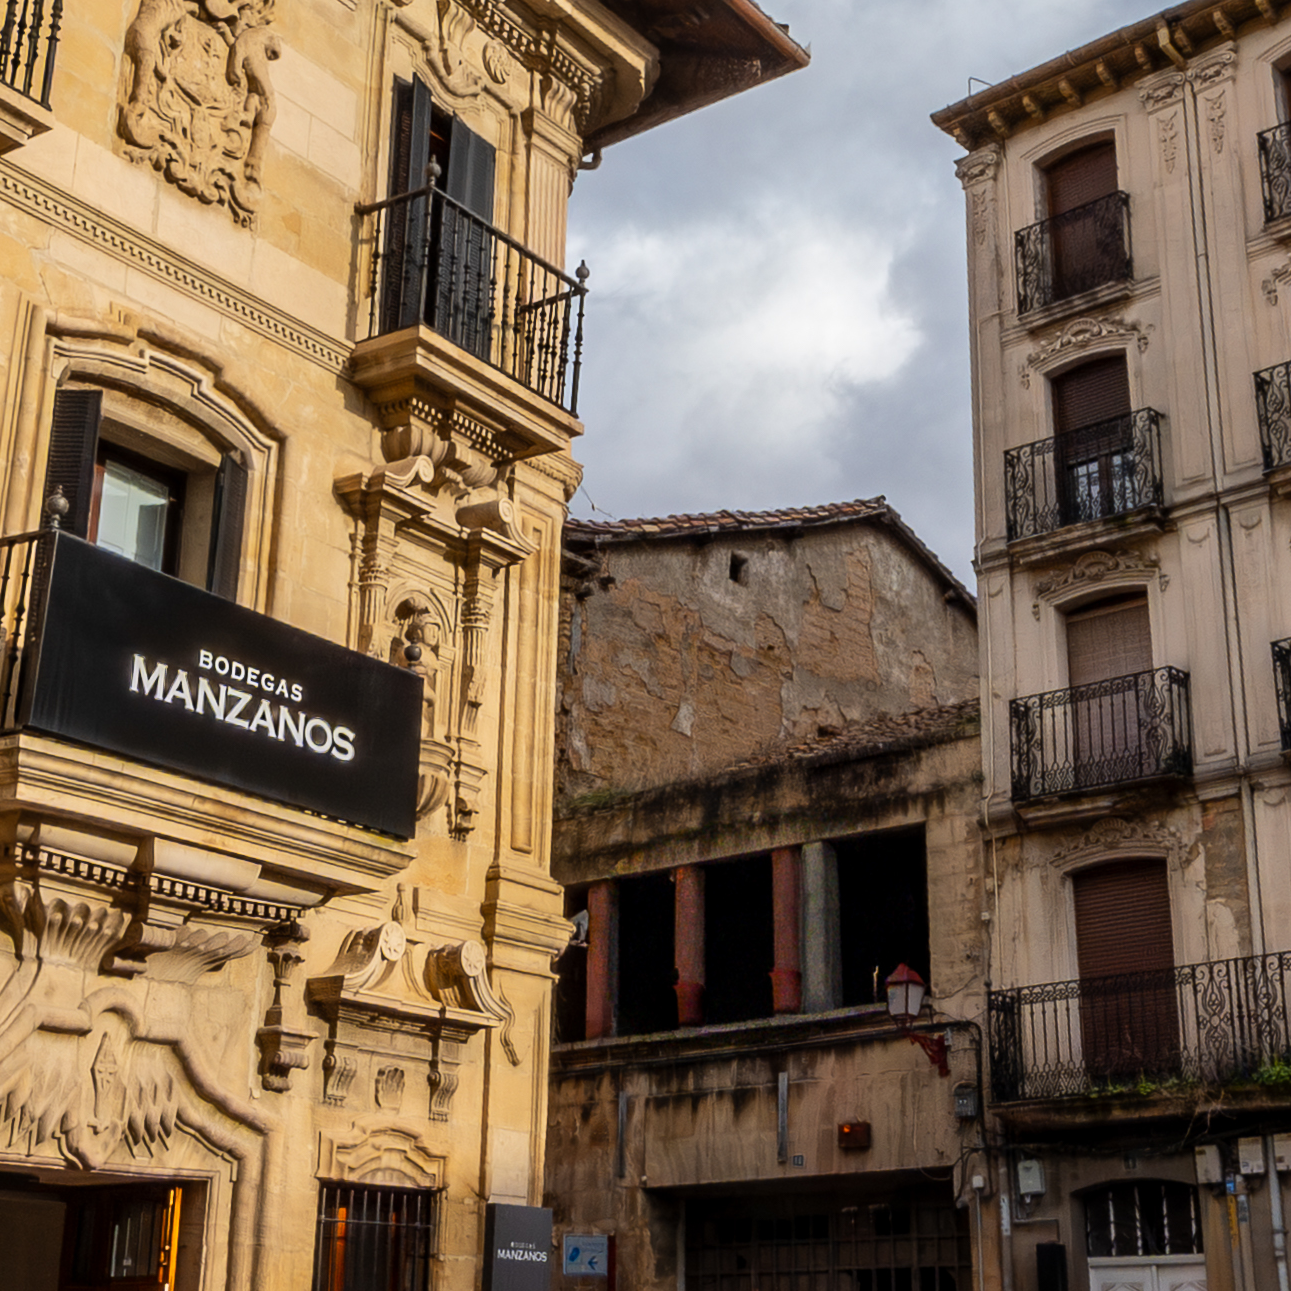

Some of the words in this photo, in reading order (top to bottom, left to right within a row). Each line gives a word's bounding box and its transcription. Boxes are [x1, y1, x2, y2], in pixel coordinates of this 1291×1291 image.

[199, 649, 303, 702] BODEGAS
[129, 653, 356, 761] MANZANOS
[497, 1249, 547, 1262] MANZANOS
